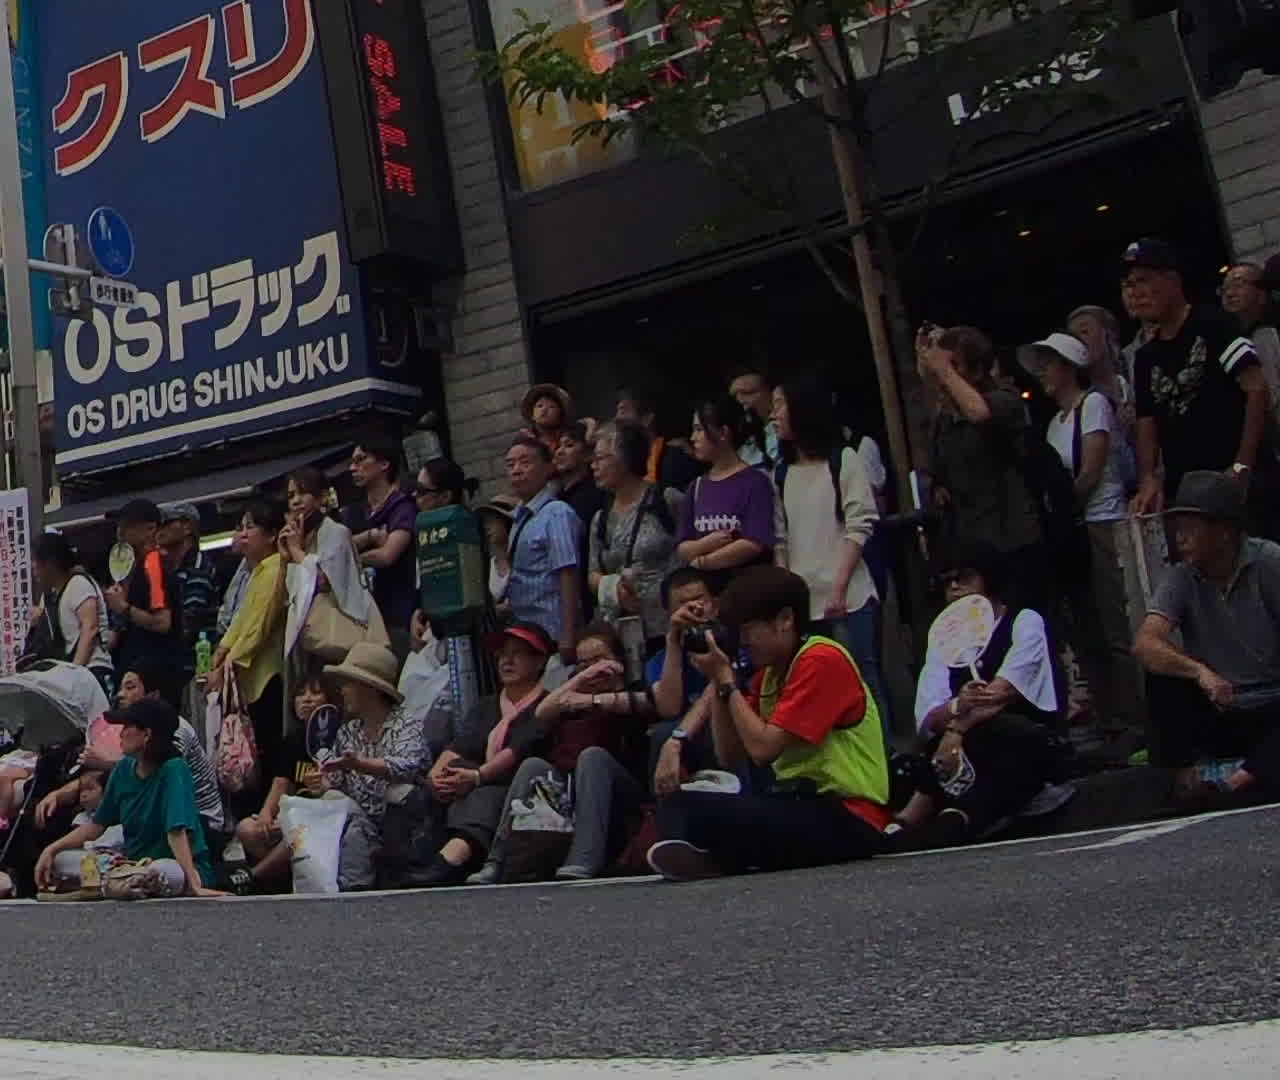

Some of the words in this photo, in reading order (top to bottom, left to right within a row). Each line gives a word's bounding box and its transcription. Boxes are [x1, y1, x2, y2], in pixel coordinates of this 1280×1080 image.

[361, 31, 417, 198] SALE
[66, 399, 106, 439] OS
[111, 378, 188, 430] DRUG
[192, 332, 350, 411] SHINJUKU
